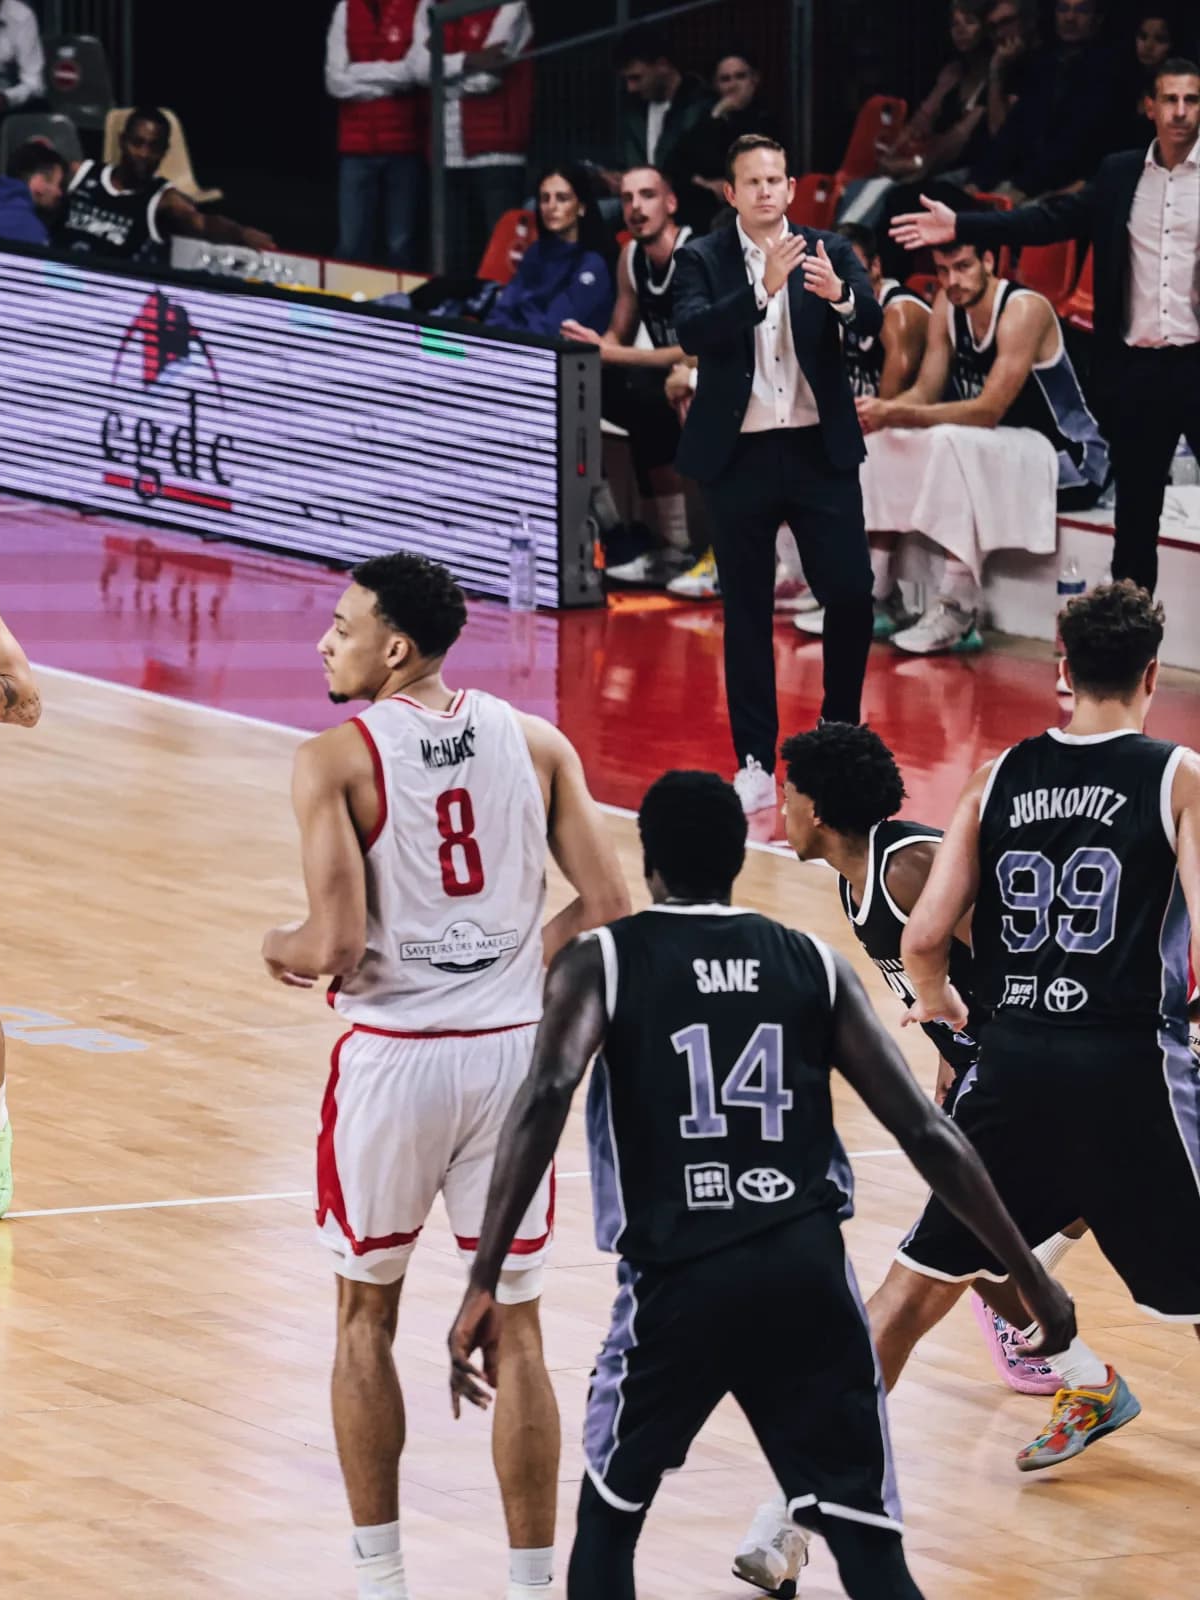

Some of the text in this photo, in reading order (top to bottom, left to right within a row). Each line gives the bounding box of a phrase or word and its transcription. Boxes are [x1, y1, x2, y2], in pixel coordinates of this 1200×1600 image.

[102, 390, 233, 500] egdc
[436, 787, 486, 897] 8
[1009, 785, 1128, 828] JURKOVITZ
[996, 847, 1122, 954] 99
[692, 958, 761, 994] SANE
[670, 1022, 793, 1142] 14
